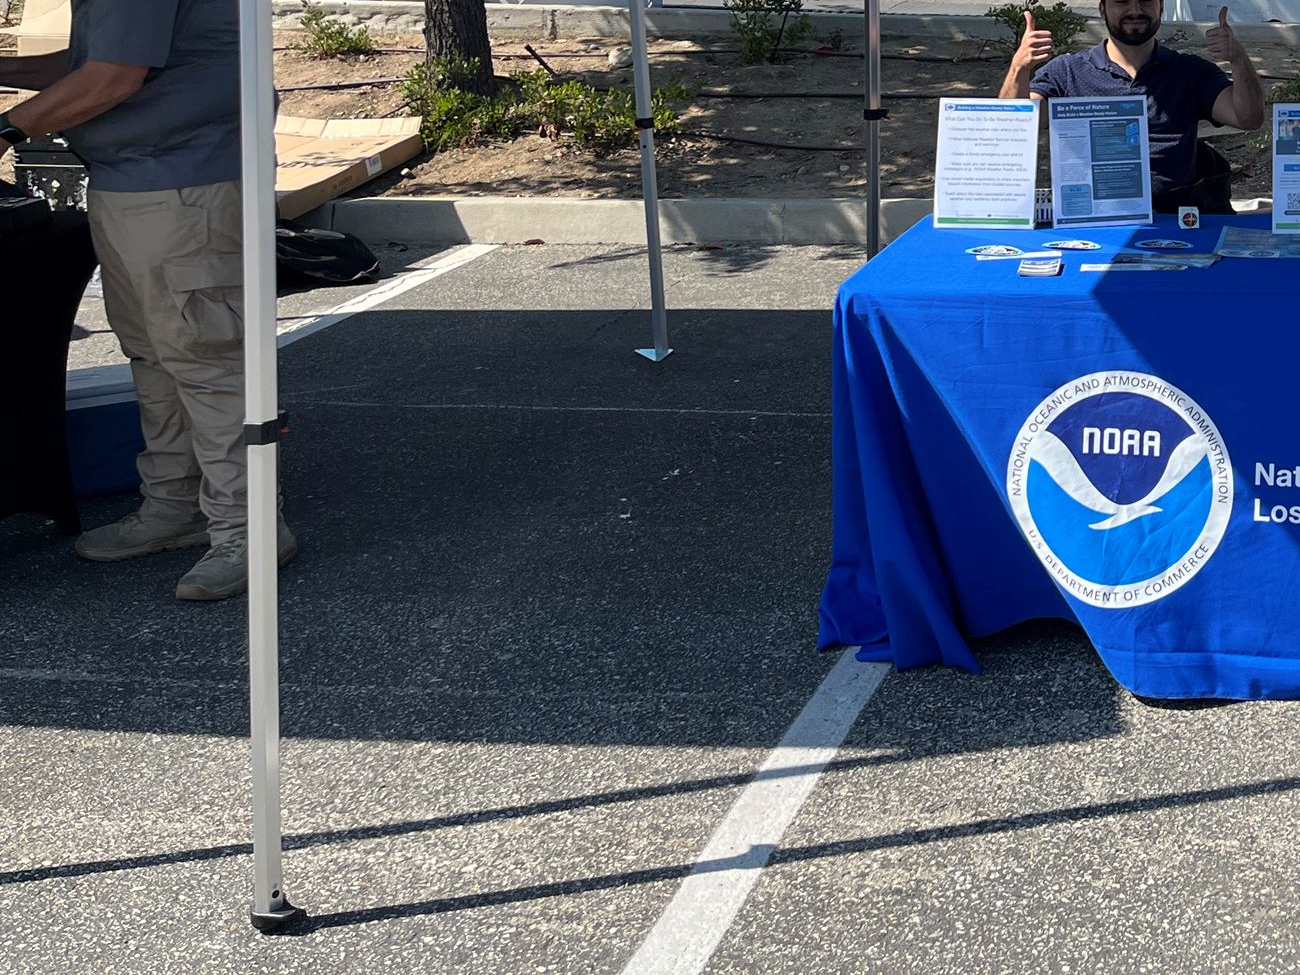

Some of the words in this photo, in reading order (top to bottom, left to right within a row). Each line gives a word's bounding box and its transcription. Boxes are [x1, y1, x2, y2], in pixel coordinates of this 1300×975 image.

[1012, 436, 1033, 496] NATIONAL
[1028, 389, 1073, 433] OCEANIC
[1074, 378, 1101, 395] AND
[1103, 375, 1186, 408] ATMOSPHERIC
[1184, 405, 1229, 504] ADMINISTRATION
[1082, 427, 1161, 457] NOAA
[1028, 528, 1043, 550] U.S.
[1044, 554, 1119, 602] DEPARTMENT
[1123, 590, 1141, 602] OF
[1144, 542, 1210, 596] COMMERCE
